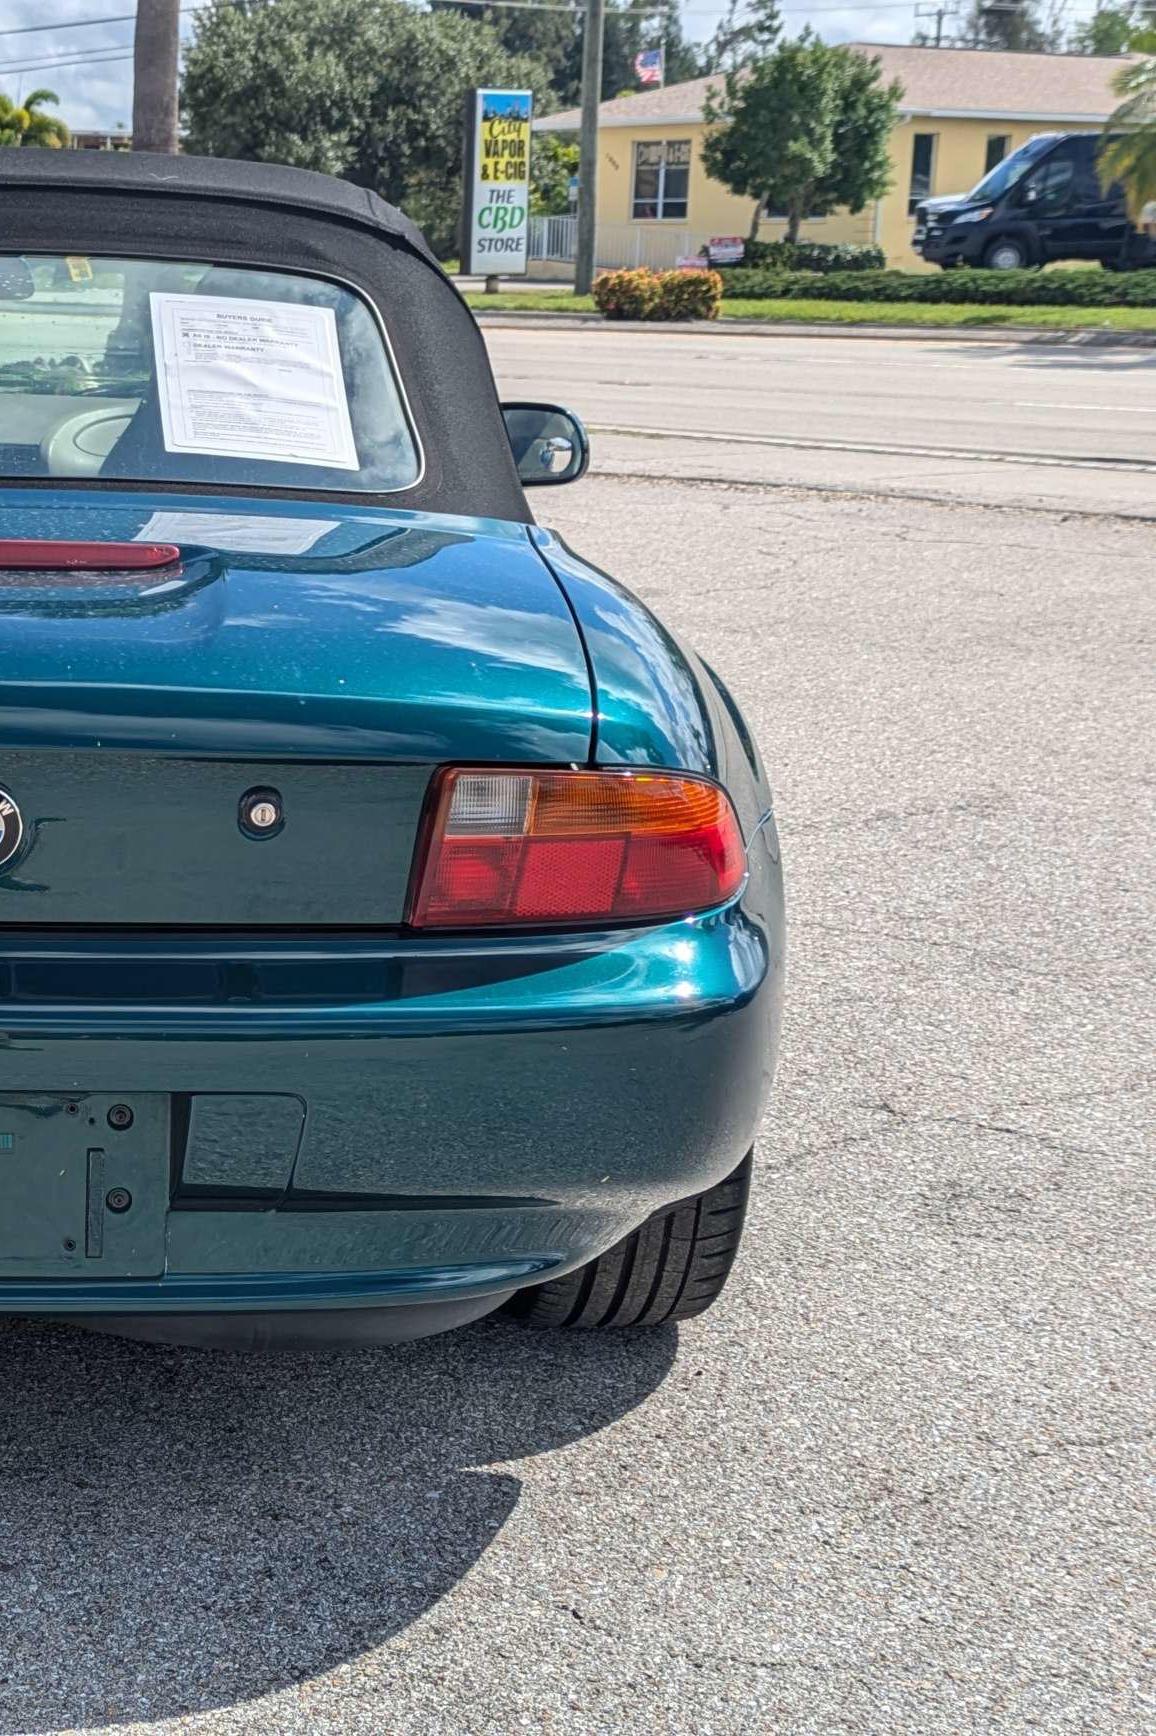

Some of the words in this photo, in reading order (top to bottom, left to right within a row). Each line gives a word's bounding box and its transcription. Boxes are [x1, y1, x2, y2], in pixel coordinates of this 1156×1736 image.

[489, 116, 522, 139] City
[484, 139, 525, 158] VAPOR
[481, 163, 489, 179] &
[493, 161, 526, 180] E-CIG
[489, 189, 515, 204] THE
[477, 206, 525, 234] CBD
[477, 237, 524, 253] STORE
[216, 313, 248, 321] BUYERS
